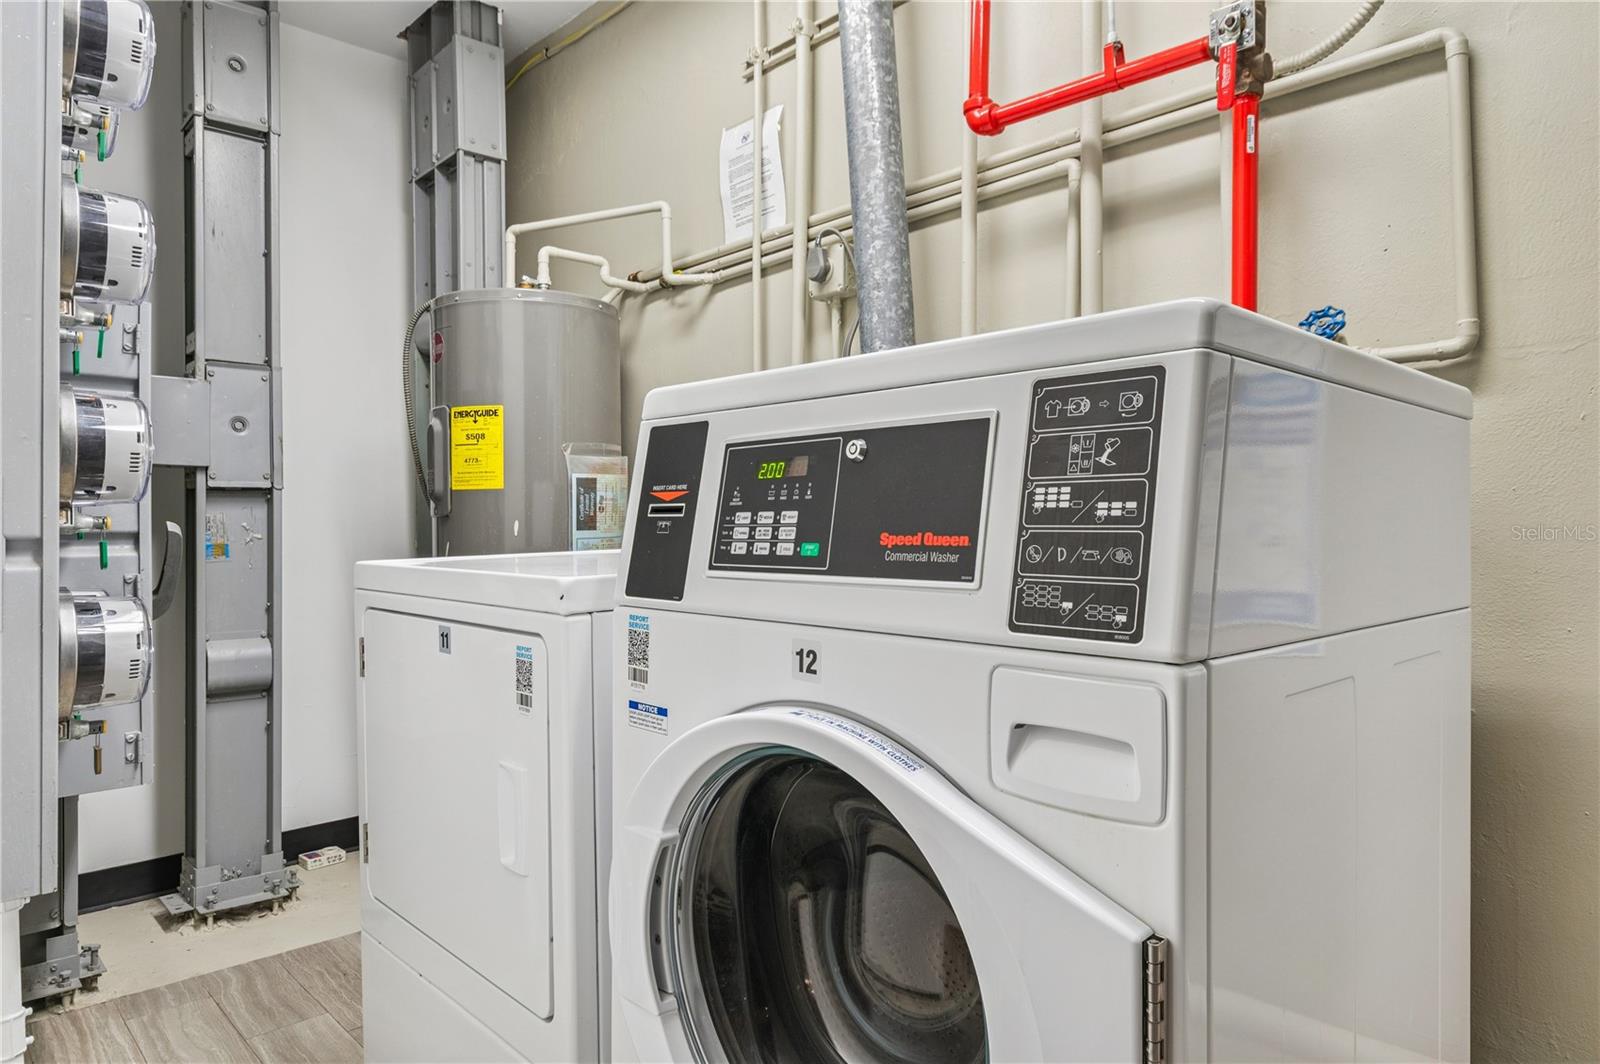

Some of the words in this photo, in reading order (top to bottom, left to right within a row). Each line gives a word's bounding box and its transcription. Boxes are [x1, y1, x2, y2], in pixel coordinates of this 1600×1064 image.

[1031, 434, 1037, 442] 2
[758, 462, 785, 479] 2.00
[880, 531, 922, 548] Speed
[923, 531, 970, 547] Queen
[885, 550, 928, 562] Commercial
[930, 551, 960, 563] Washer
[628, 621, 650, 630] SERVICE
[629, 614, 649, 623] REPORT
[440, 631, 449, 649] 11
[795, 648, 817, 675] 12
[638, 703, 658, 715] NOTICE
[868, 736, 888, 752] WITH
[887, 749, 920, 773] CLOTHES
